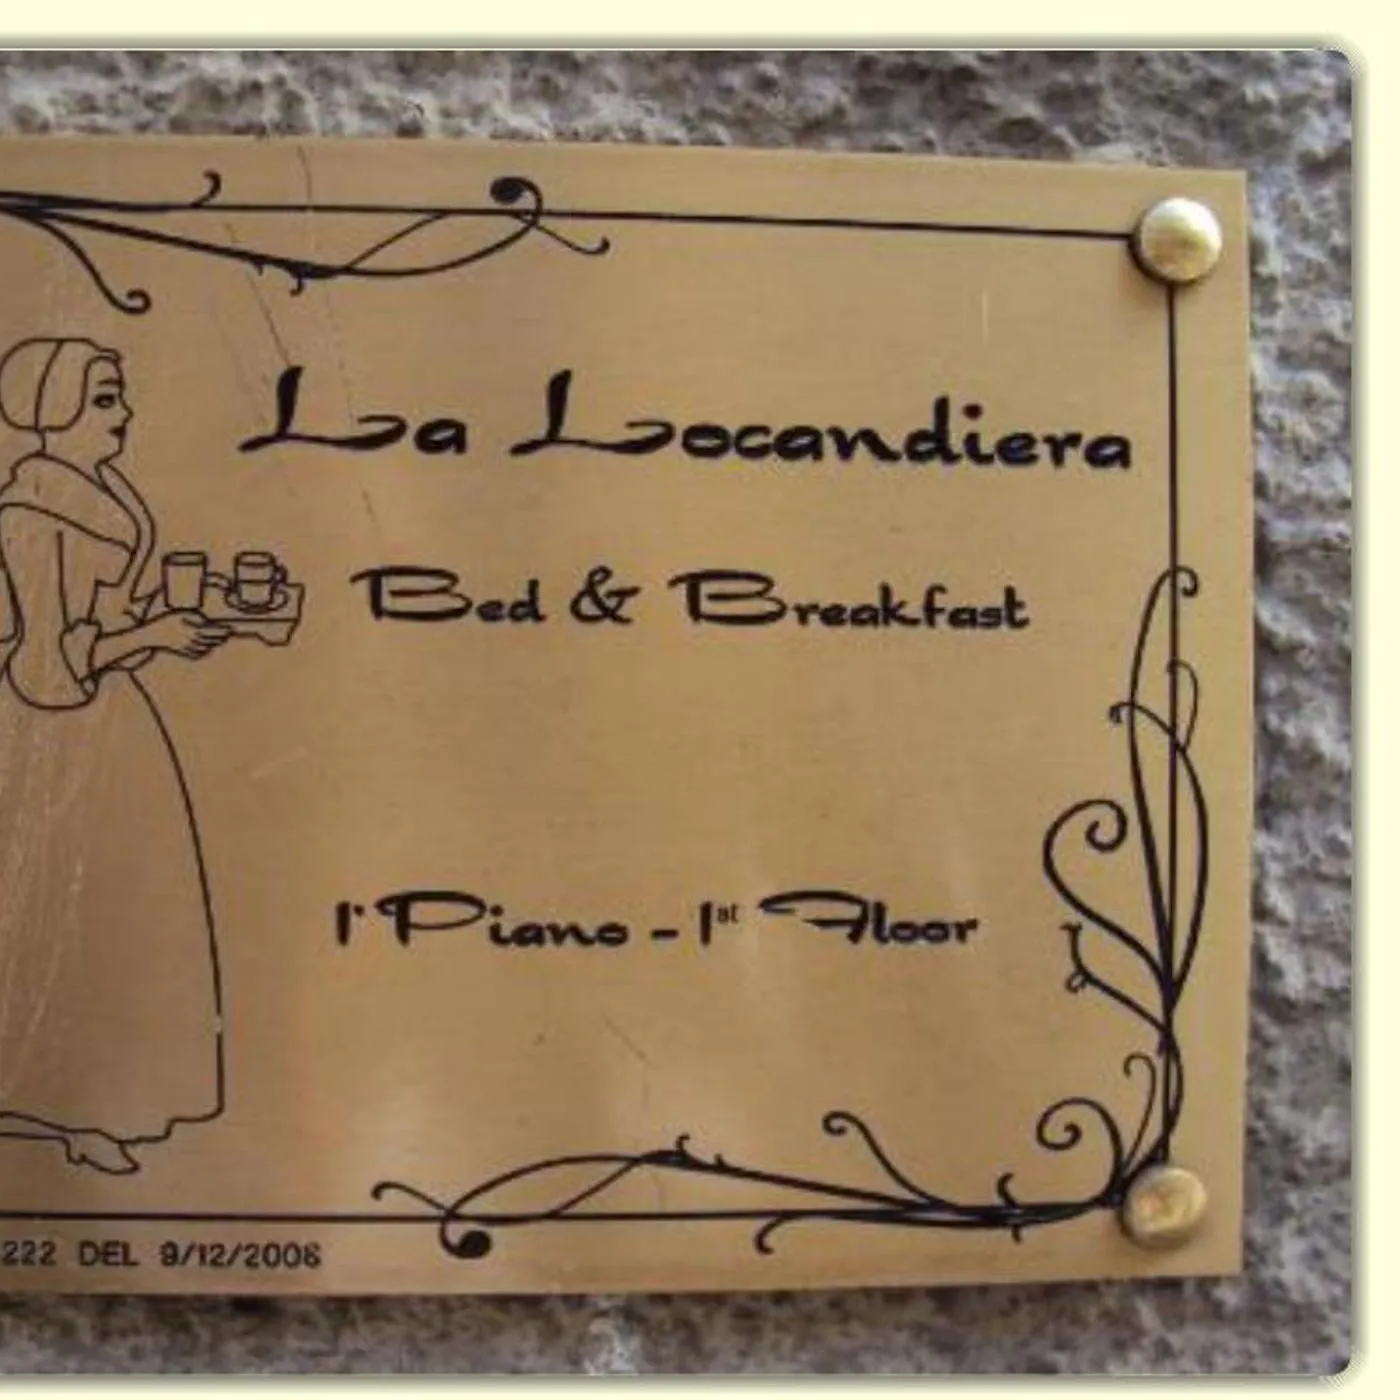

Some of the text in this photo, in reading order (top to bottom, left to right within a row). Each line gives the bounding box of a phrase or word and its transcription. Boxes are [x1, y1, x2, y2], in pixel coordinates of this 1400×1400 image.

[238, 366, 1133, 470] La Locandiera
[350, 565, 1030, 631] Bed & Breakfast
[374, 890, 630, 948] Piano
[758, 890, 979, 946] Floor
[79, 1240, 140, 1268] DEL
